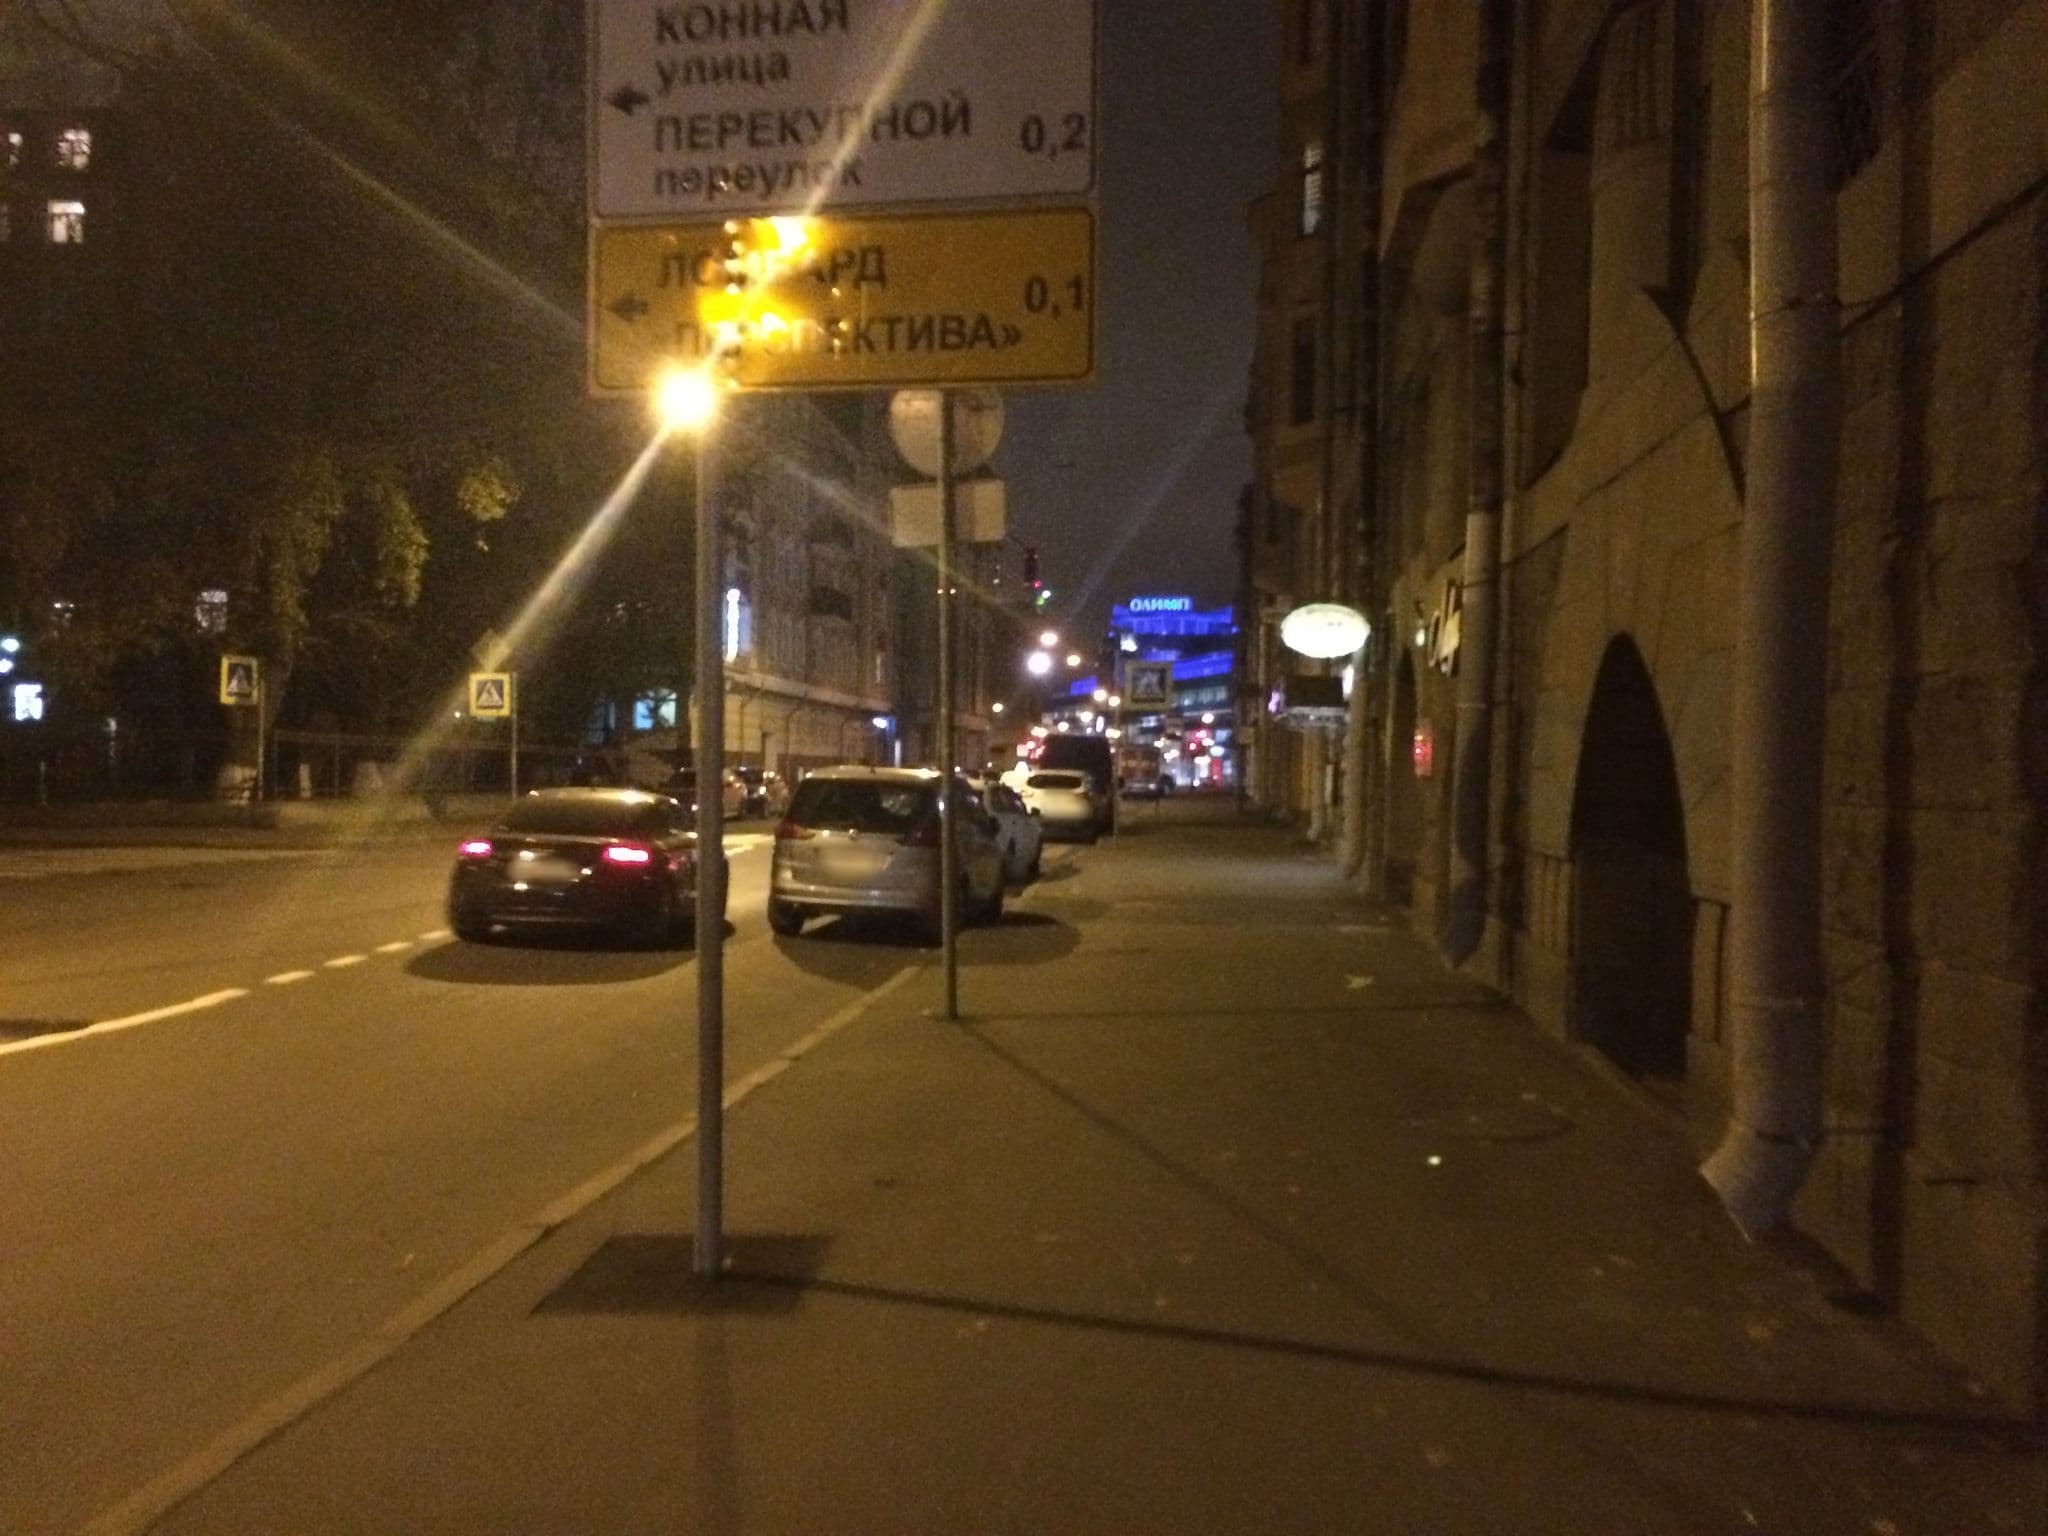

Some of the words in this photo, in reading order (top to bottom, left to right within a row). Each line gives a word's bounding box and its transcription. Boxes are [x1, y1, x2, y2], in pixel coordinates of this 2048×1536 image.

[655, 0, 849, 43] КОННАЯ
[655, 52, 791, 94] улица
[655, 89, 970, 151] ПЕРЕКУПНОЙ
[1021, 112, 1086, 161] 0,2
[655, 156, 862, 200] переулк
[656, 244, 887, 288] ЛОРД
[1024, 275, 1082, 320] 0,1
